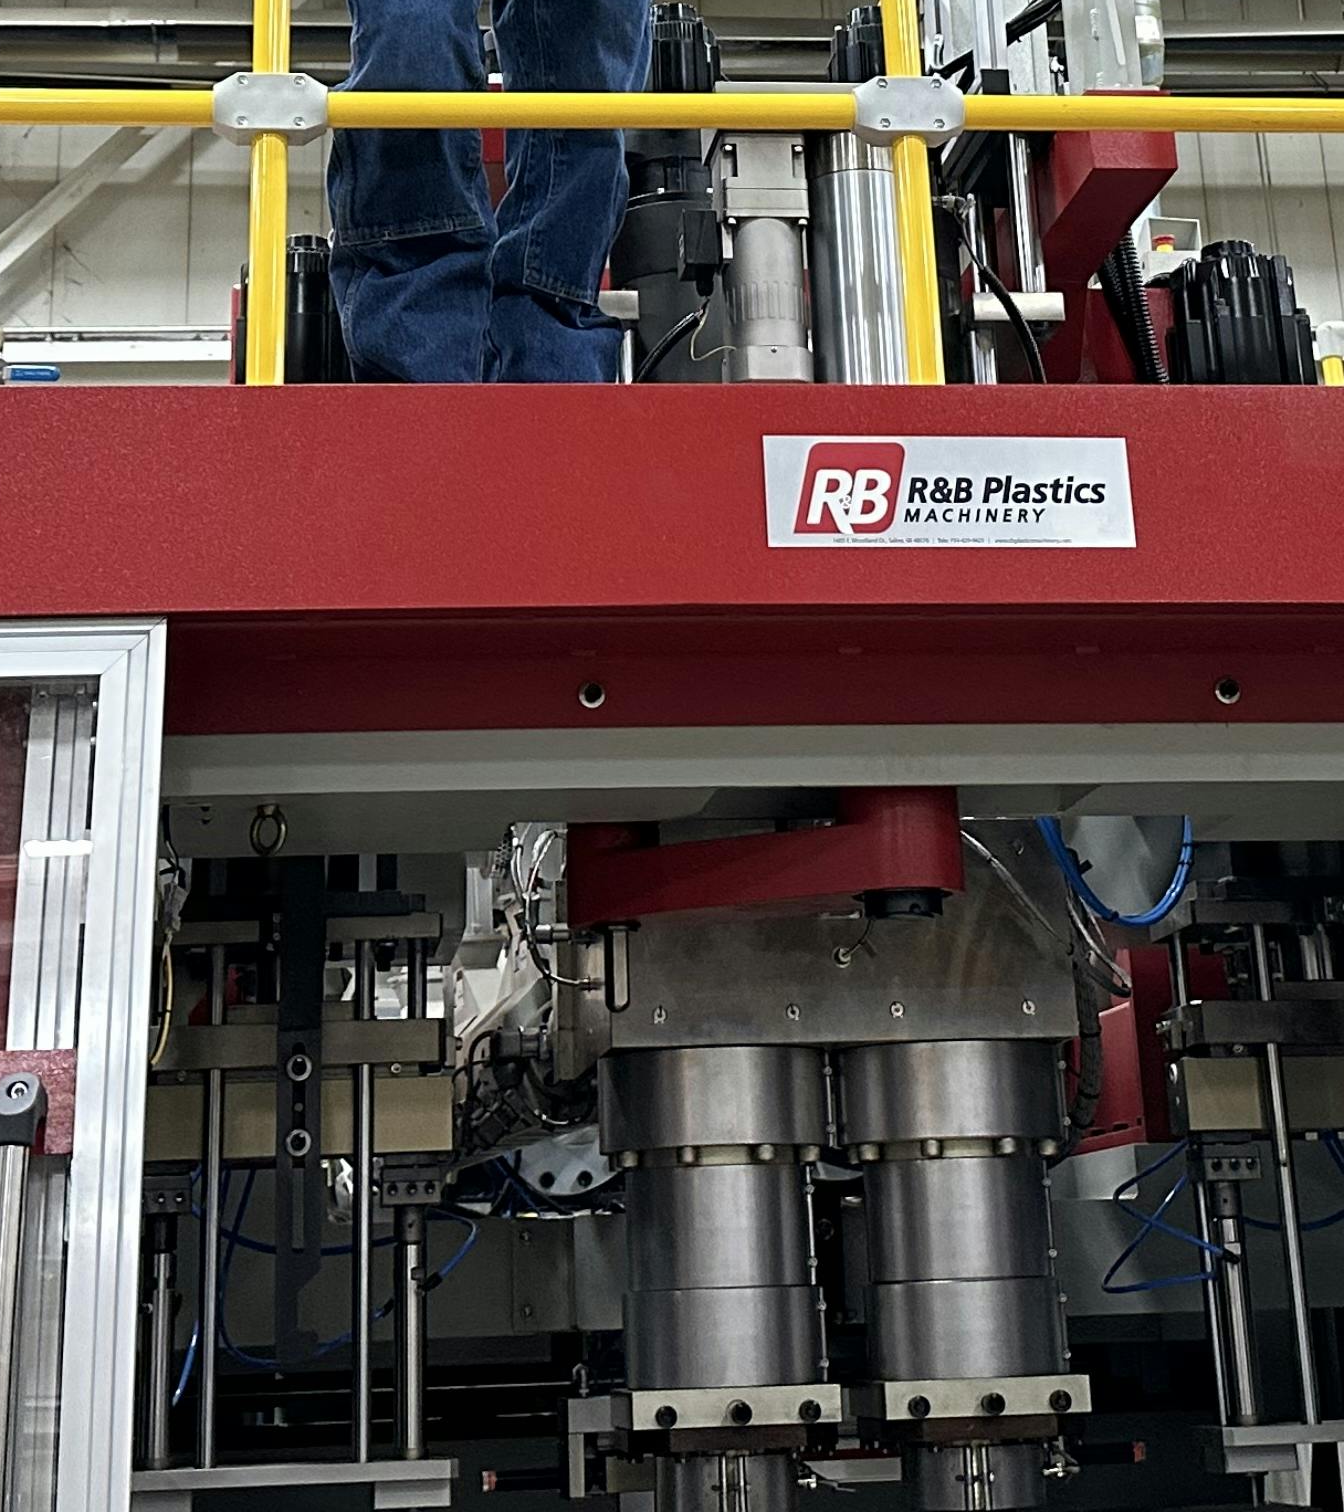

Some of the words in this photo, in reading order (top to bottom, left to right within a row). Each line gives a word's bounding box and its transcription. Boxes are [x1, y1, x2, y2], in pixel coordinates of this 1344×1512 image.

[907, 476, 973, 504] R&B
[983, 475, 1105, 504] Plastics
[903, 507, 1046, 524] MACHINERY
